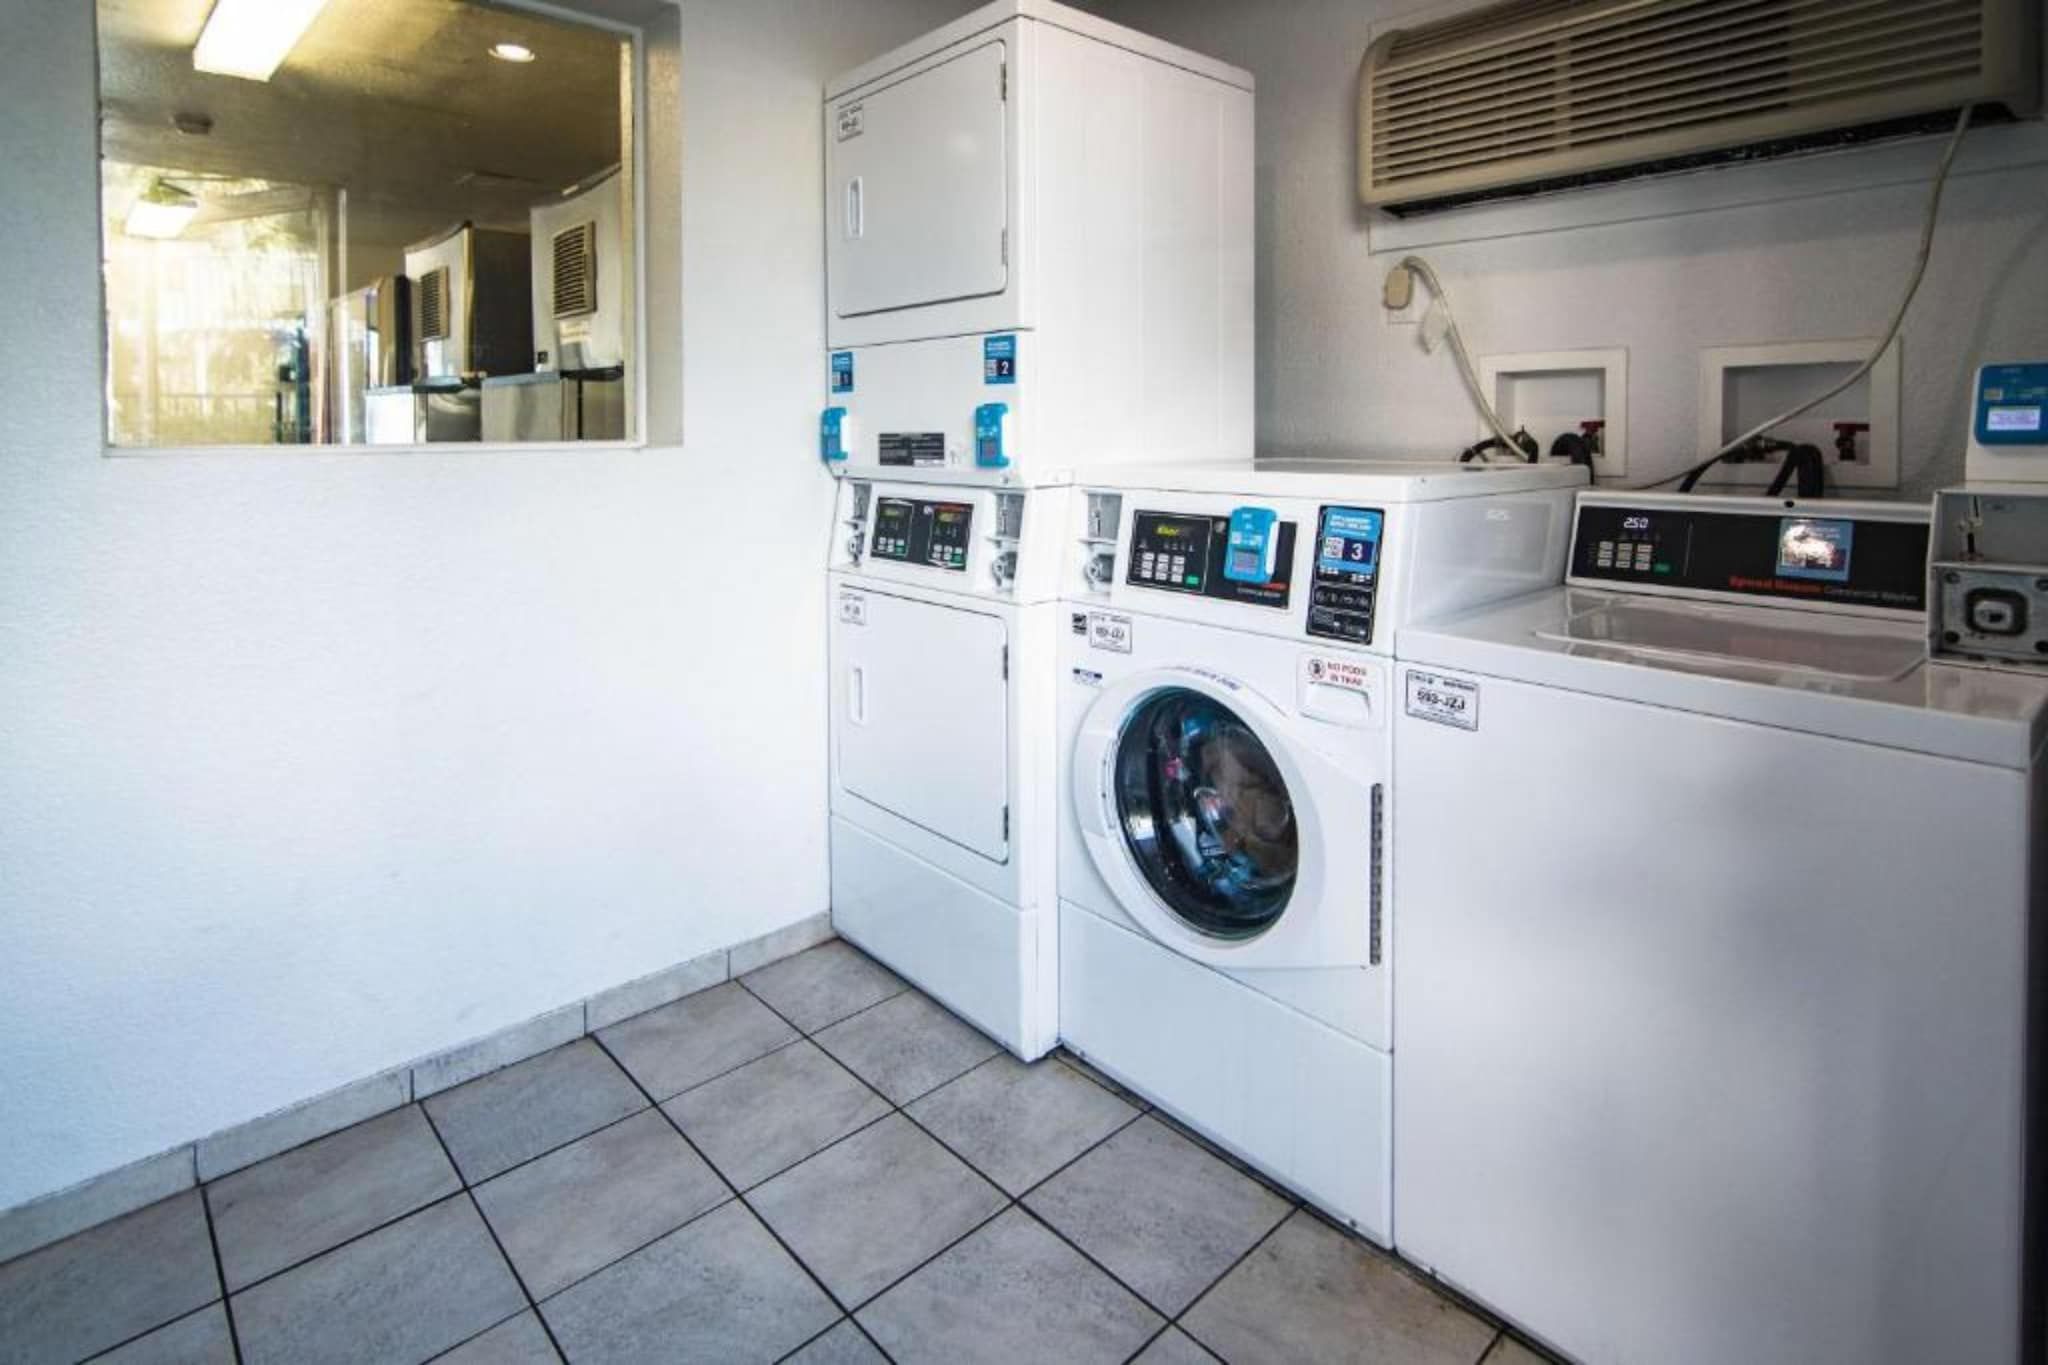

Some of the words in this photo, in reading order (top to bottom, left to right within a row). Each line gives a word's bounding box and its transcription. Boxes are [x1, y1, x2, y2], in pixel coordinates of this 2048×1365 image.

[1001, 360, 1009, 375] 2
[1623, 517, 1649, 529] 250
[1351, 543, 1363, 560] 3
